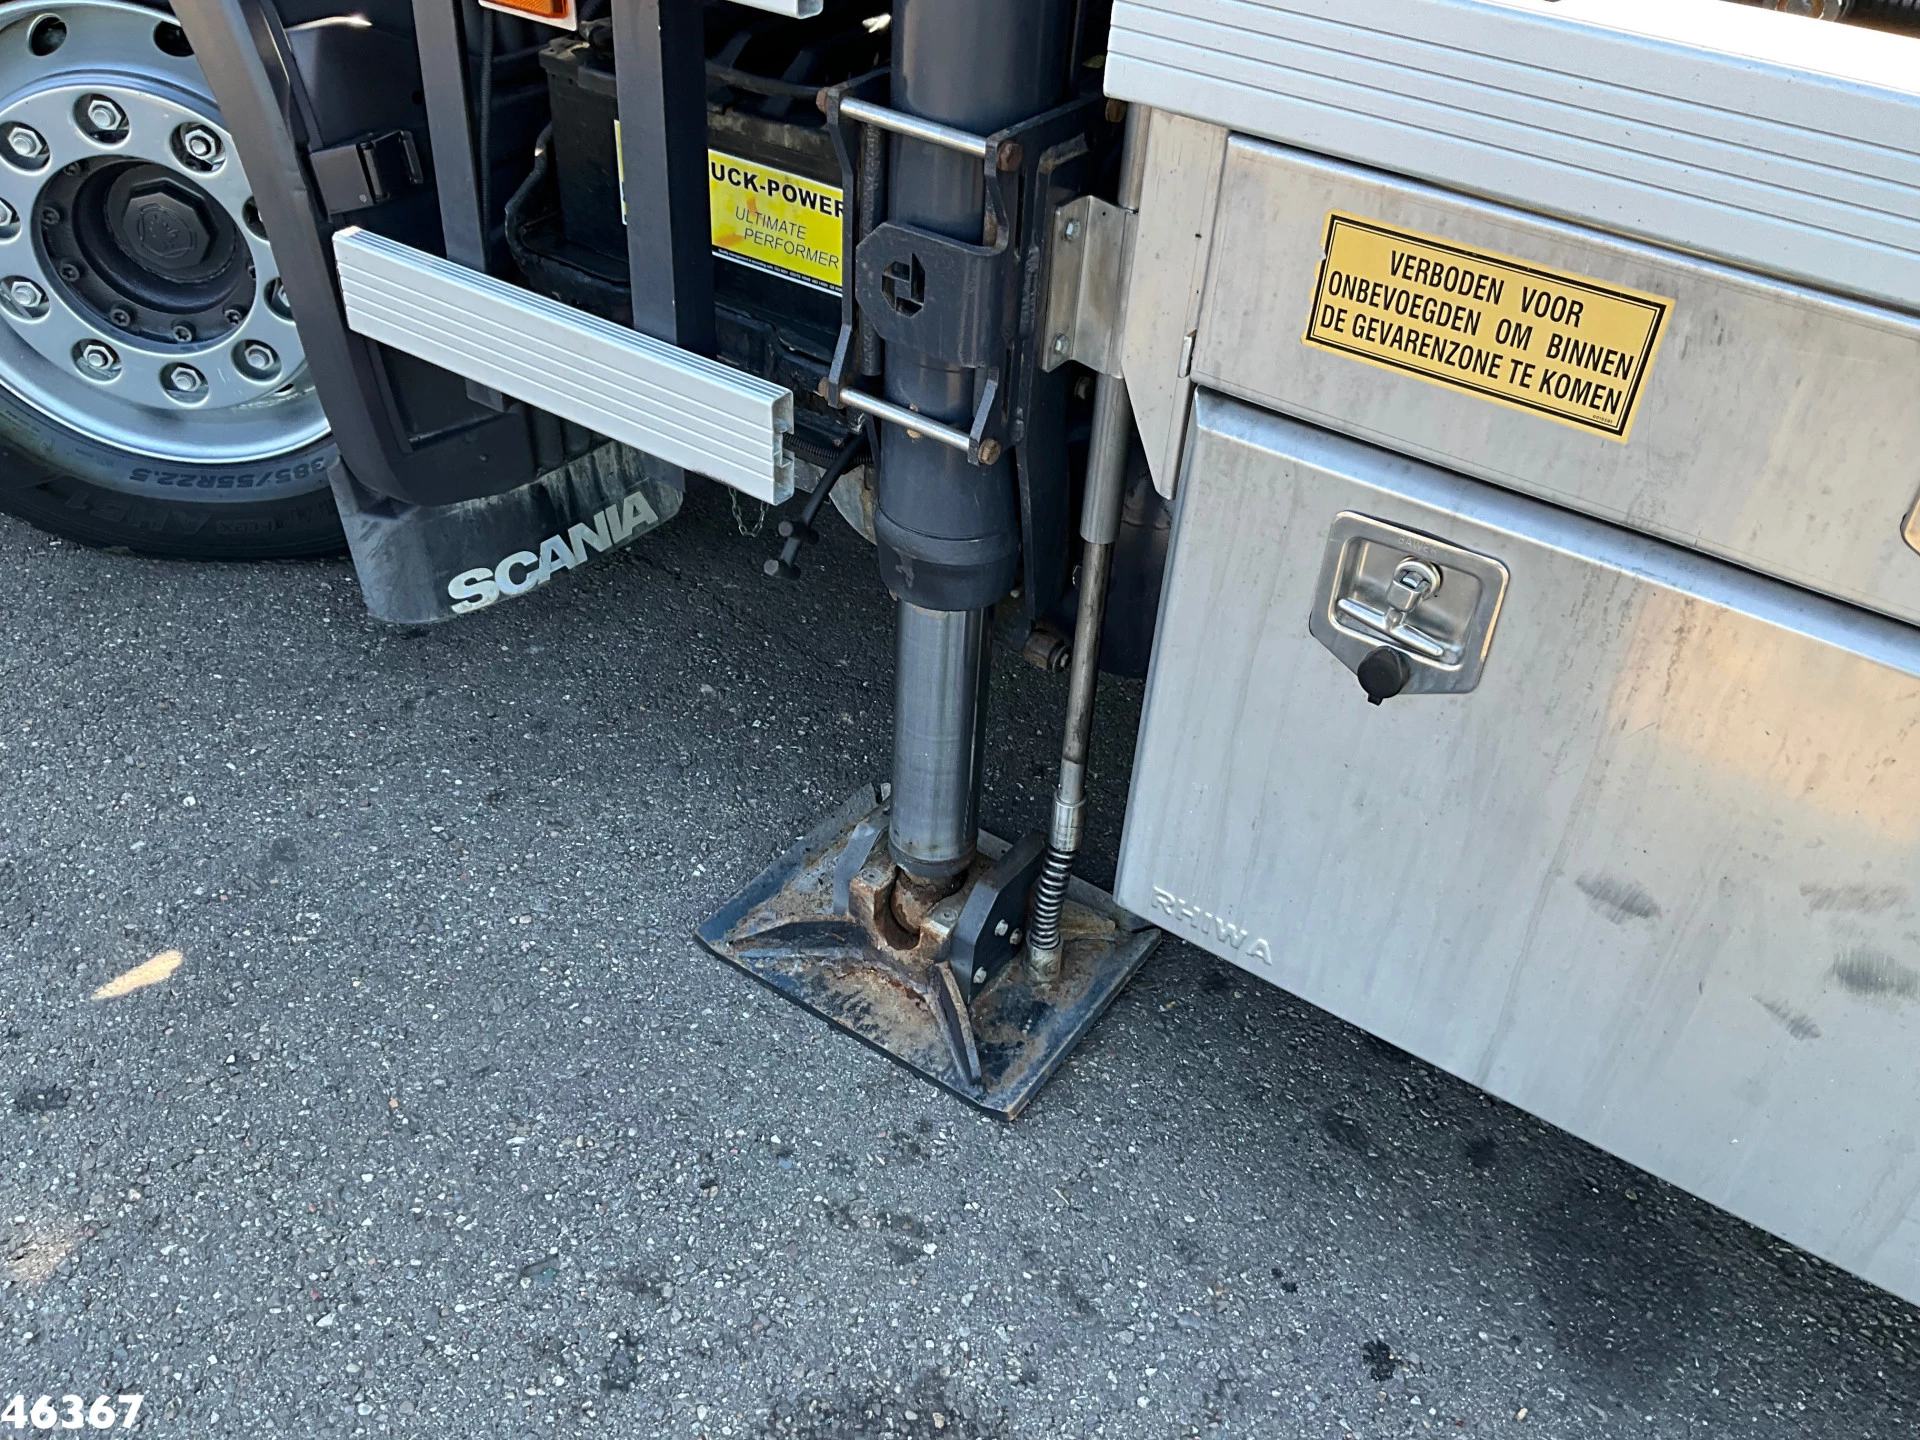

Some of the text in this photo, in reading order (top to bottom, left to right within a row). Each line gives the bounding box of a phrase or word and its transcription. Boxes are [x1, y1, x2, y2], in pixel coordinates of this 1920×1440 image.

[735, 205, 806, 240] ULTIMATE
[744, 228, 839, 270] PERFORMER
[1328, 271, 1635, 382] ONBEVOEGDEN OM BINNEN
[1390, 250, 1584, 328] VERBODEN VOOR
[1320, 304, 1623, 415] DE GEVARENZONE TE KOMEN
[130, 457, 328, 489] 385/55R22.5
[447, 490, 659, 614] SCANIA
[1151, 884, 1273, 967] RHIWA
